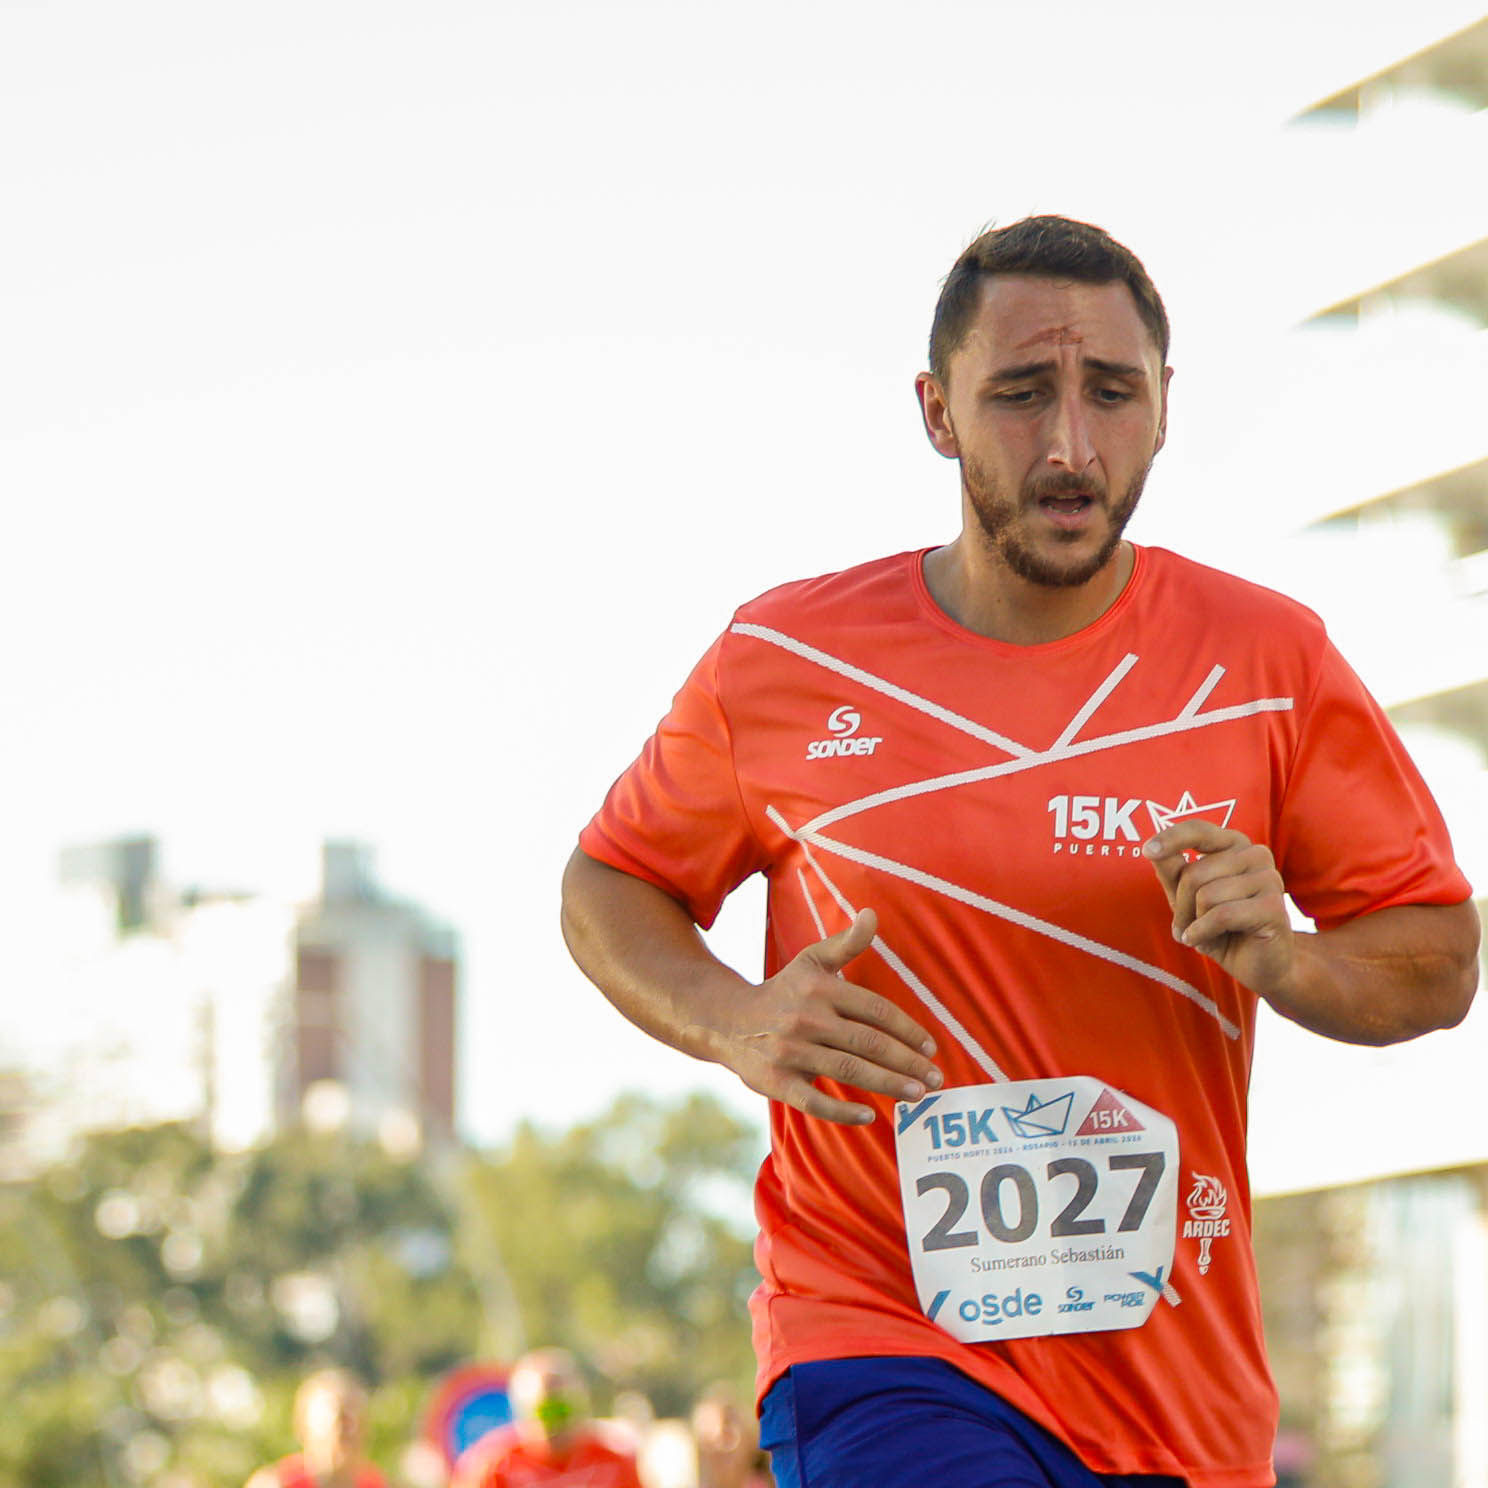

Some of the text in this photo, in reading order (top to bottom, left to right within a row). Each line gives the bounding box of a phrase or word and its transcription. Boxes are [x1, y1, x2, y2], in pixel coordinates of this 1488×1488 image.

[1047, 795, 1142, 842] 15K
[1053, 843, 1143, 858] PUERTO
[922, 1107, 1000, 1150] 15K
[1089, 1107, 1130, 1130] 15K
[915, 1151, 1166, 1253] 2027
[1182, 1218, 1231, 1239] ARDEC
[970, 1247, 1125, 1273] Sumerano Sebastián
[958, 1287, 1043, 1325] osde
